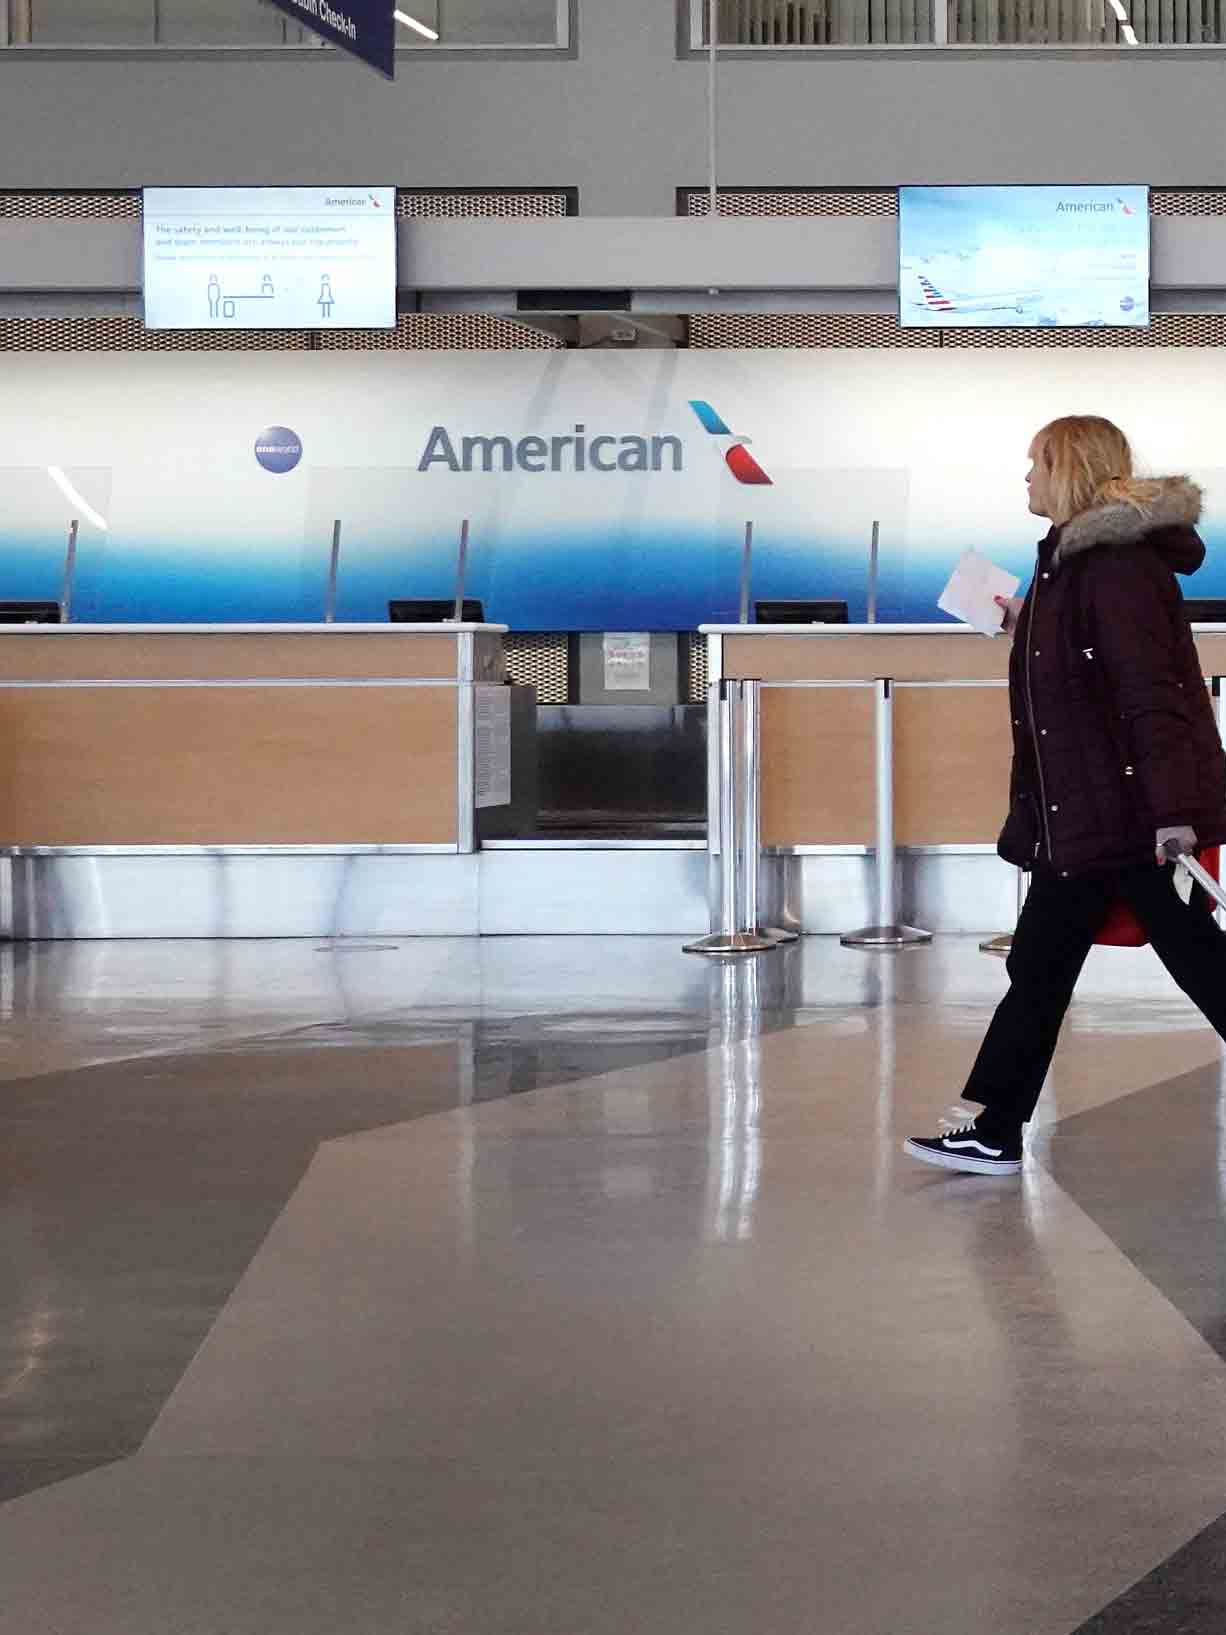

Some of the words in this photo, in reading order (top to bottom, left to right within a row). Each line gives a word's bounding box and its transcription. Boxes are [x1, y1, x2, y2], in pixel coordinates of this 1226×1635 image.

[291, 0, 318, 16] abin
[319, 0, 357, 40] Check-In
[324, 197, 367, 207] American
[1056, 200, 1114, 212] American
[417, 424, 683, 472] American
